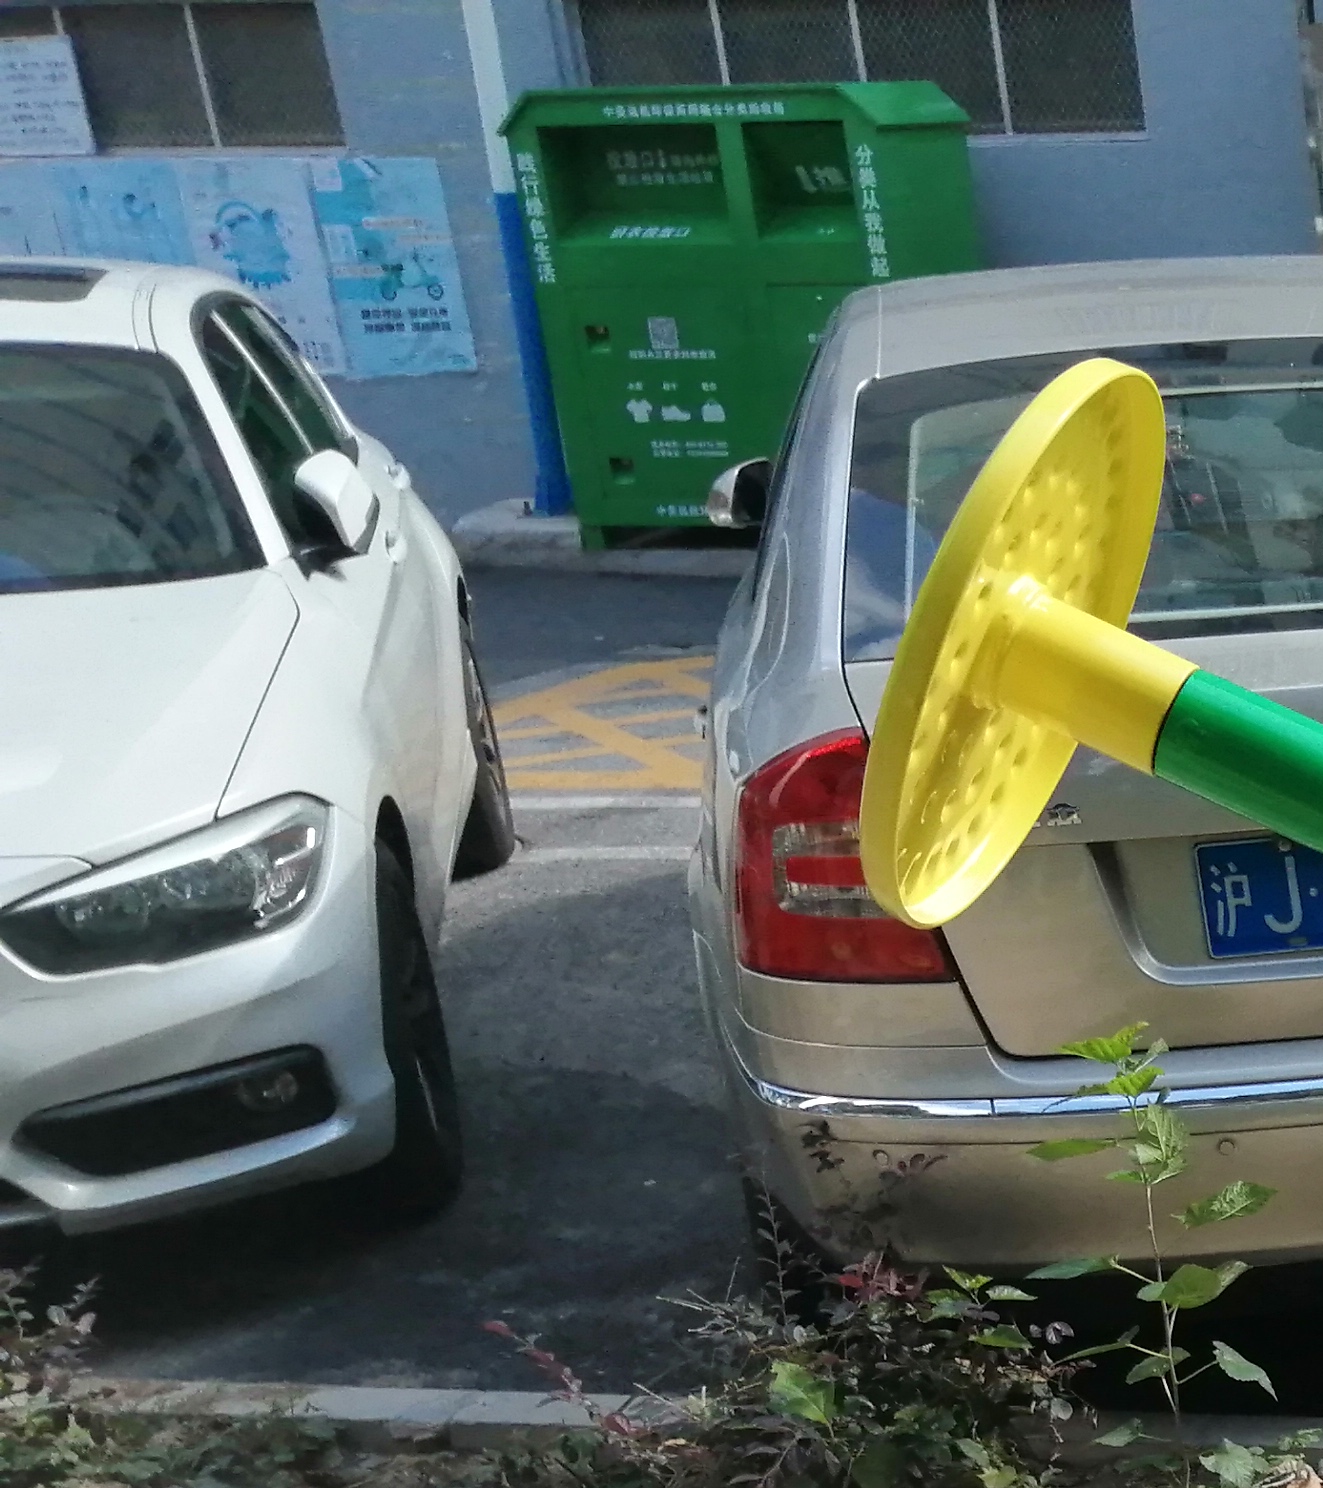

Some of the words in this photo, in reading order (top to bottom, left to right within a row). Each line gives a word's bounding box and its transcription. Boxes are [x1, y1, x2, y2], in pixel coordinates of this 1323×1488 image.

[855, 144, 890, 277] 分类从我做起
